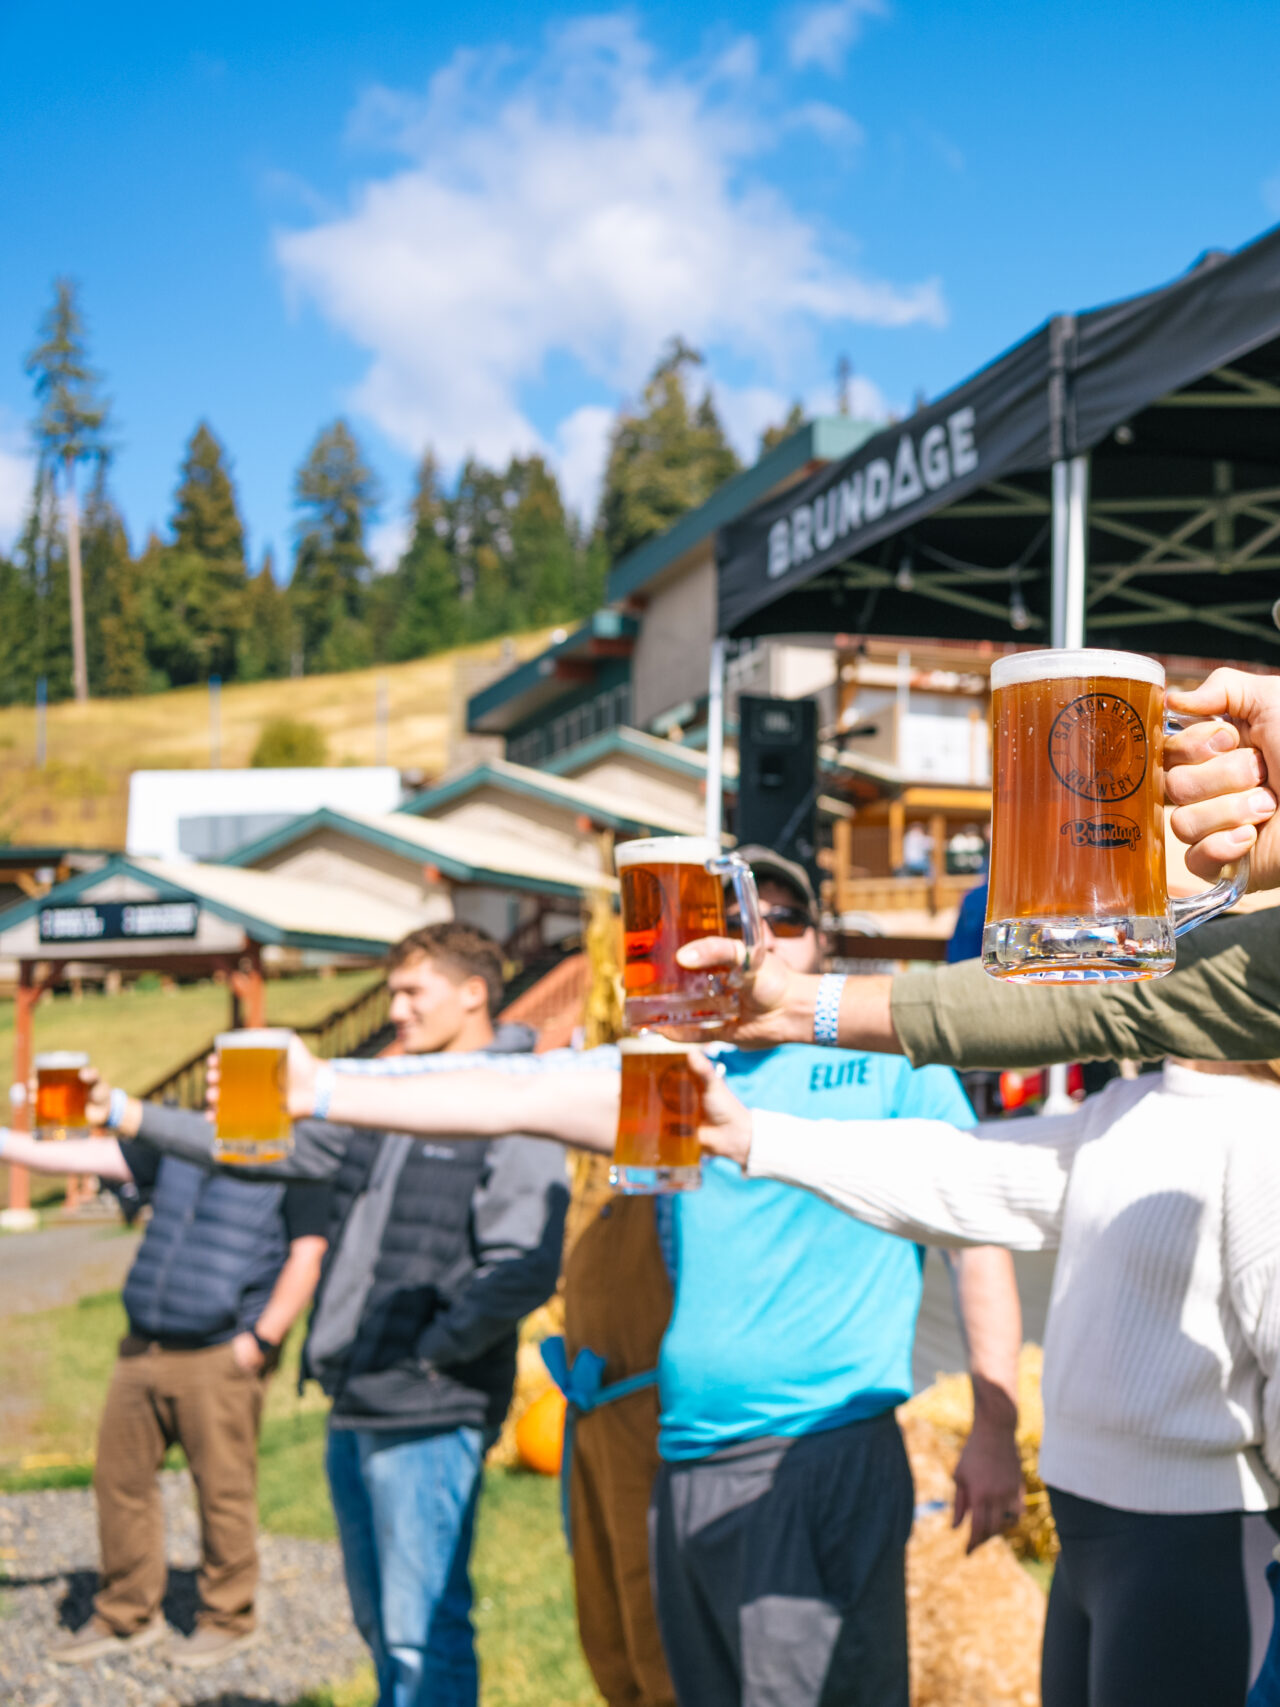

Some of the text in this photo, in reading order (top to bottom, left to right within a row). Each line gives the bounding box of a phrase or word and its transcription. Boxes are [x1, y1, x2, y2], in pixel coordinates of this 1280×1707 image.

[767, 406, 979, 579] BRUNDAGE
[1054, 698, 1144, 743] SALMON RIVER
[1065, 769, 1135, 797] BREWERY
[1060, 818, 1141, 851] Brundage
[809, 1056, 871, 1091] ELITE
